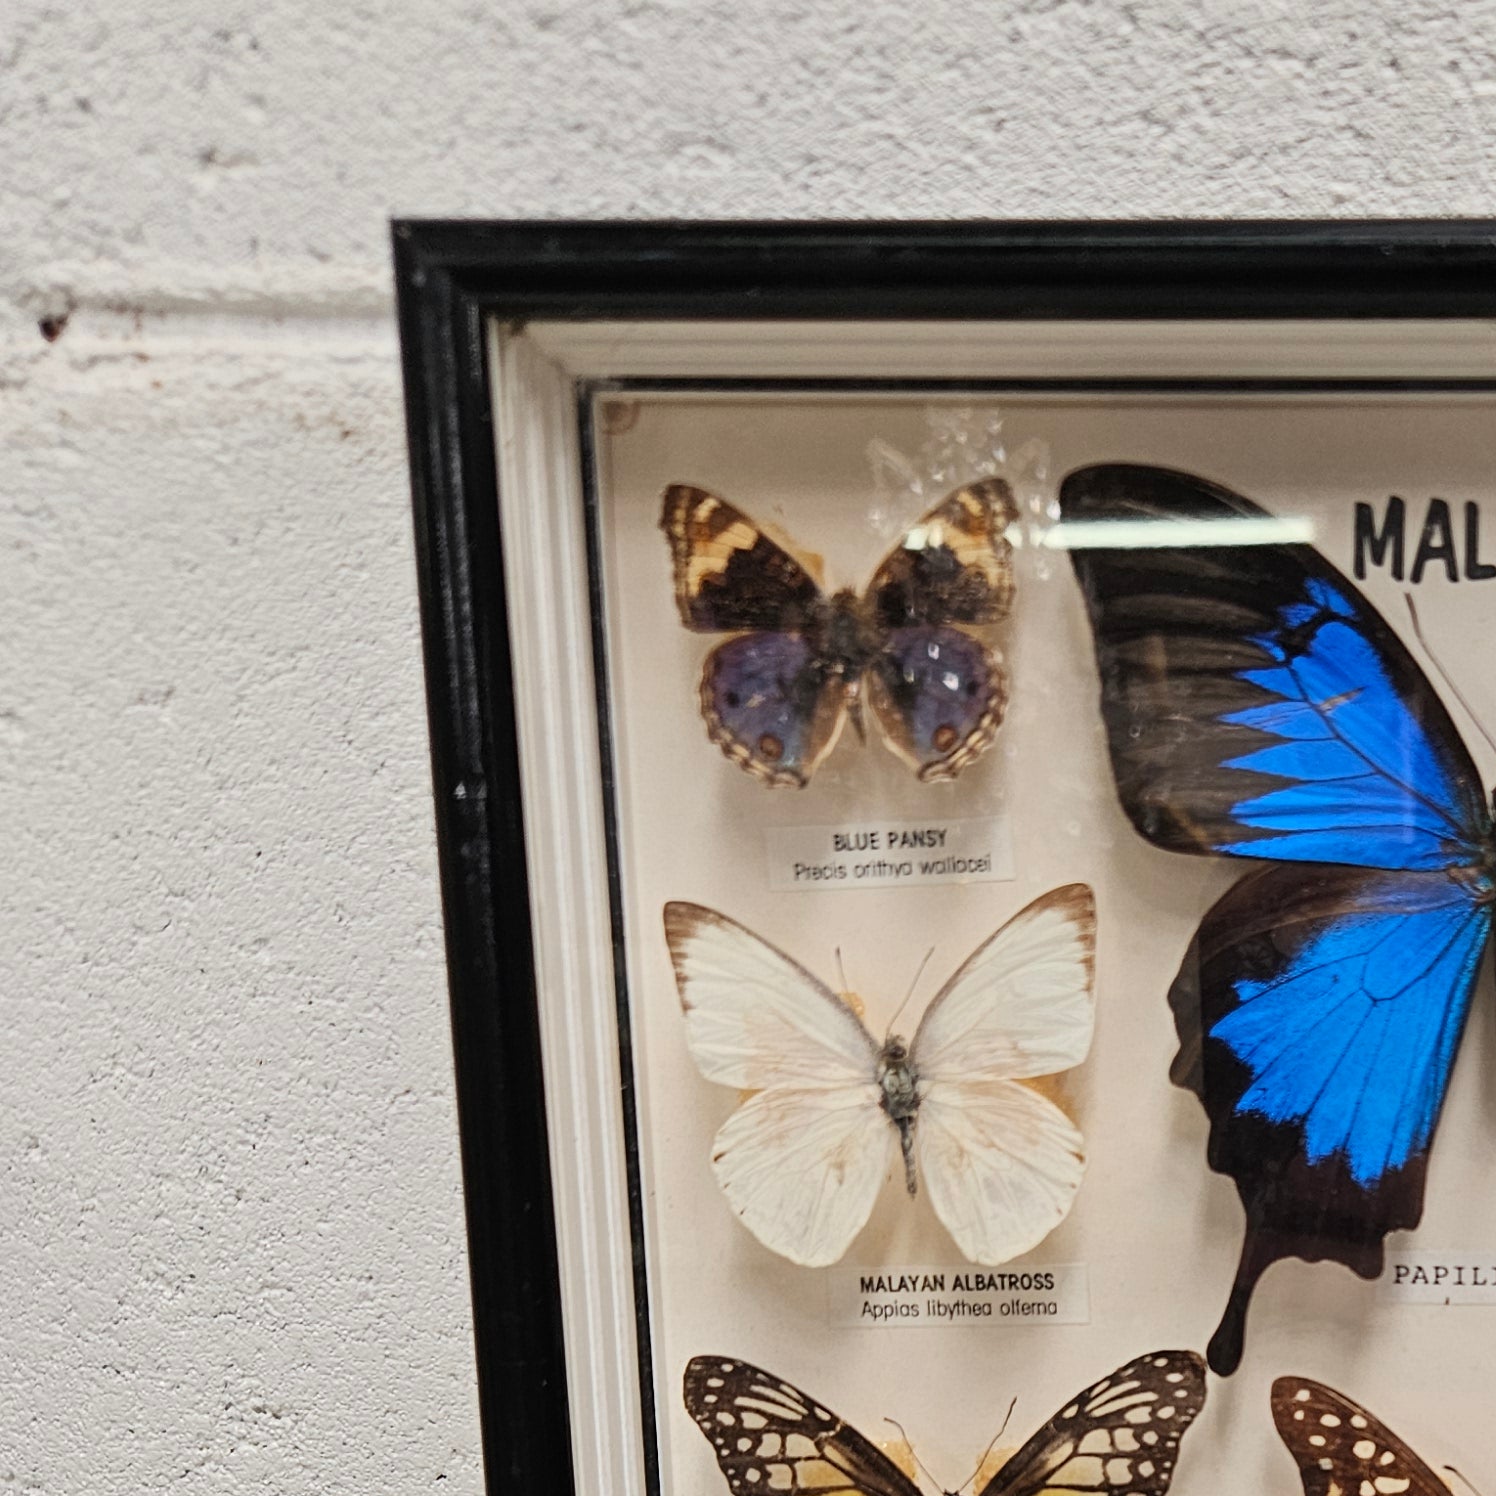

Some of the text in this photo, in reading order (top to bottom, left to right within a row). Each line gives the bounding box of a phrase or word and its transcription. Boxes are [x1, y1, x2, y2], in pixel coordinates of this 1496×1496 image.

[833, 829, 947, 852] BLUE PANSY
[860, 1273, 1055, 1294] MALAYAN ALBATROSS
[861, 1299, 1058, 1320] Appias libythea olferna
